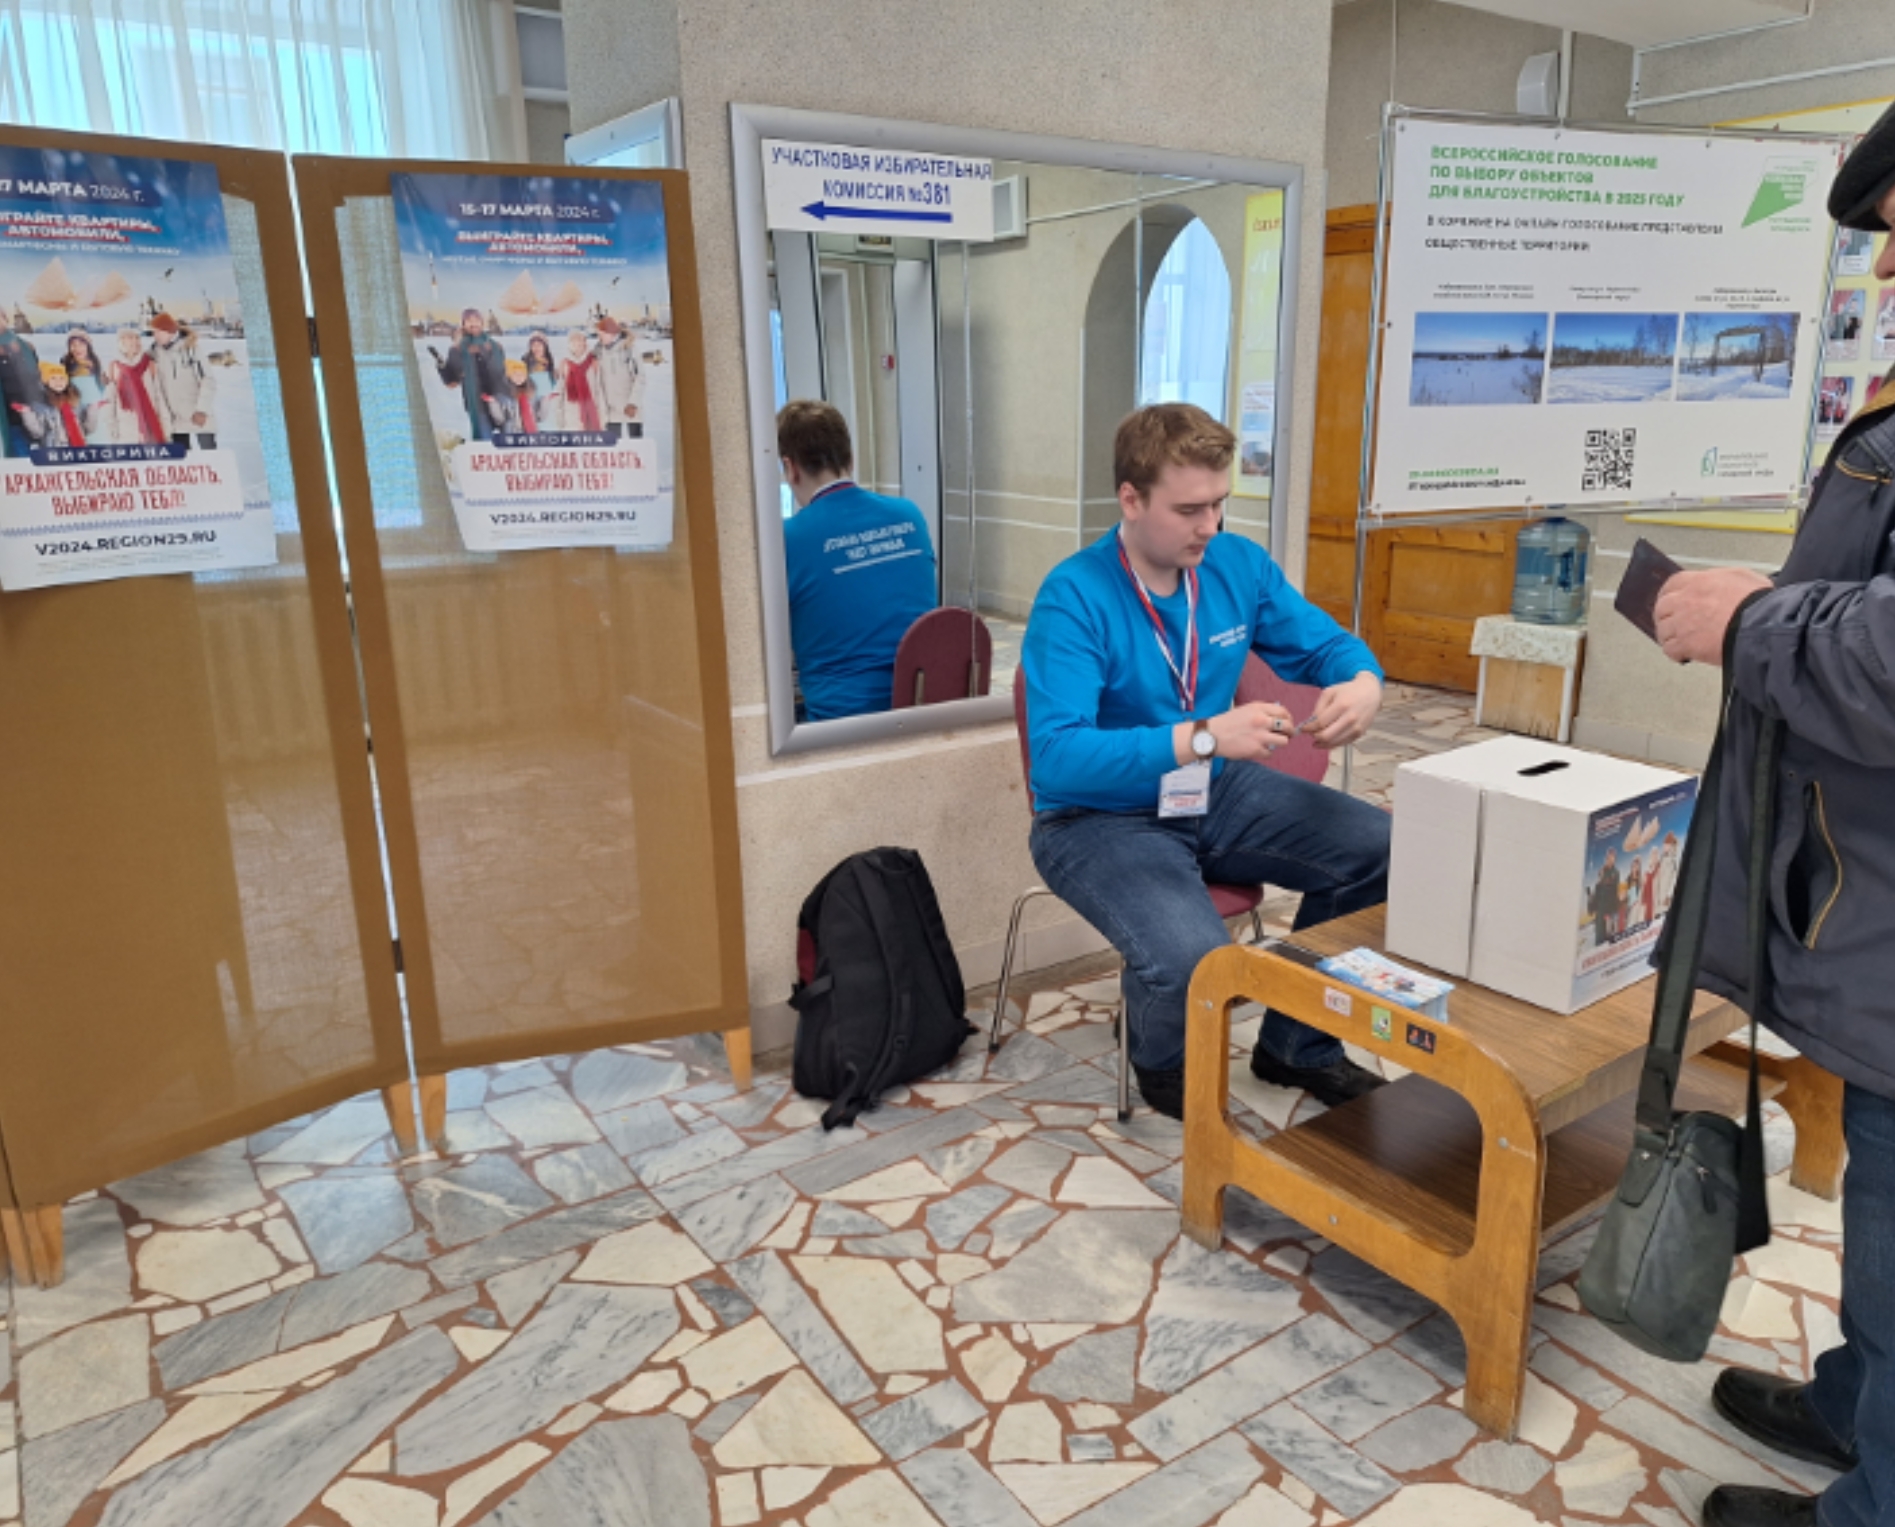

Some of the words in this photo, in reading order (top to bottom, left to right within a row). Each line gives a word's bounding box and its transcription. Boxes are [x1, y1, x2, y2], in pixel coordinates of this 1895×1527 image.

[772, 147, 871, 173] УЧАСТКОВАЯ
[875, 155, 992, 180] ИЗБИРАТЕЛЬНАЯ
[1431, 145, 1554, 164] ВСЕРОССИЙСКОЕ
[1557, 152, 1659, 169] ГОЛОСОВАНИЕ
[1430, 166, 1450, 179] ПО
[1455, 167, 1516, 182] ВЫБОРУ
[1519, 171, 1594, 184] ОБЪЕКТОВ
[17, 180, 87, 197] МАРТА
[89, 185, 130, 200] 2024
[823, 180, 905, 202] КОМИССИЯ
[908, 182, 951, 205] №381
[1429, 185, 1459, 199] ДЛЯ
[1463, 186, 1601, 204] БЛАГОУСТРОЙСТВА
[1604, 192, 1613, 204] В
[1649, 194, 1685, 208] ГОДУ
[500, 204, 553, 217] МАРТА
[556, 206, 589, 218] 2024
[67, 215, 157, 233] КВАРТИРЫ,
[505, 435, 604, 446] ВИКТОРИНА
[49, 446, 171, 462] ВИКТОРИНА
[470, 452, 578, 472] АРХАНГЕЛЬСКАЯ
[582, 451, 646, 469] ОБЛАСТЬ,
[5, 467, 140, 496] АРХАНГЕЛЬСКАЯ
[146, 465, 222, 486] ОБЛАСТЬ,
[505, 473, 573, 492] ВЫБИРАЮ
[578, 473, 614, 491] ТЕБЯ!
[51, 491, 134, 517] ВЫБИРАЮ
[489, 511, 637, 525] V2024.REGION29.RU
[35, 529, 217, 556] V2024.REGION29.RU
